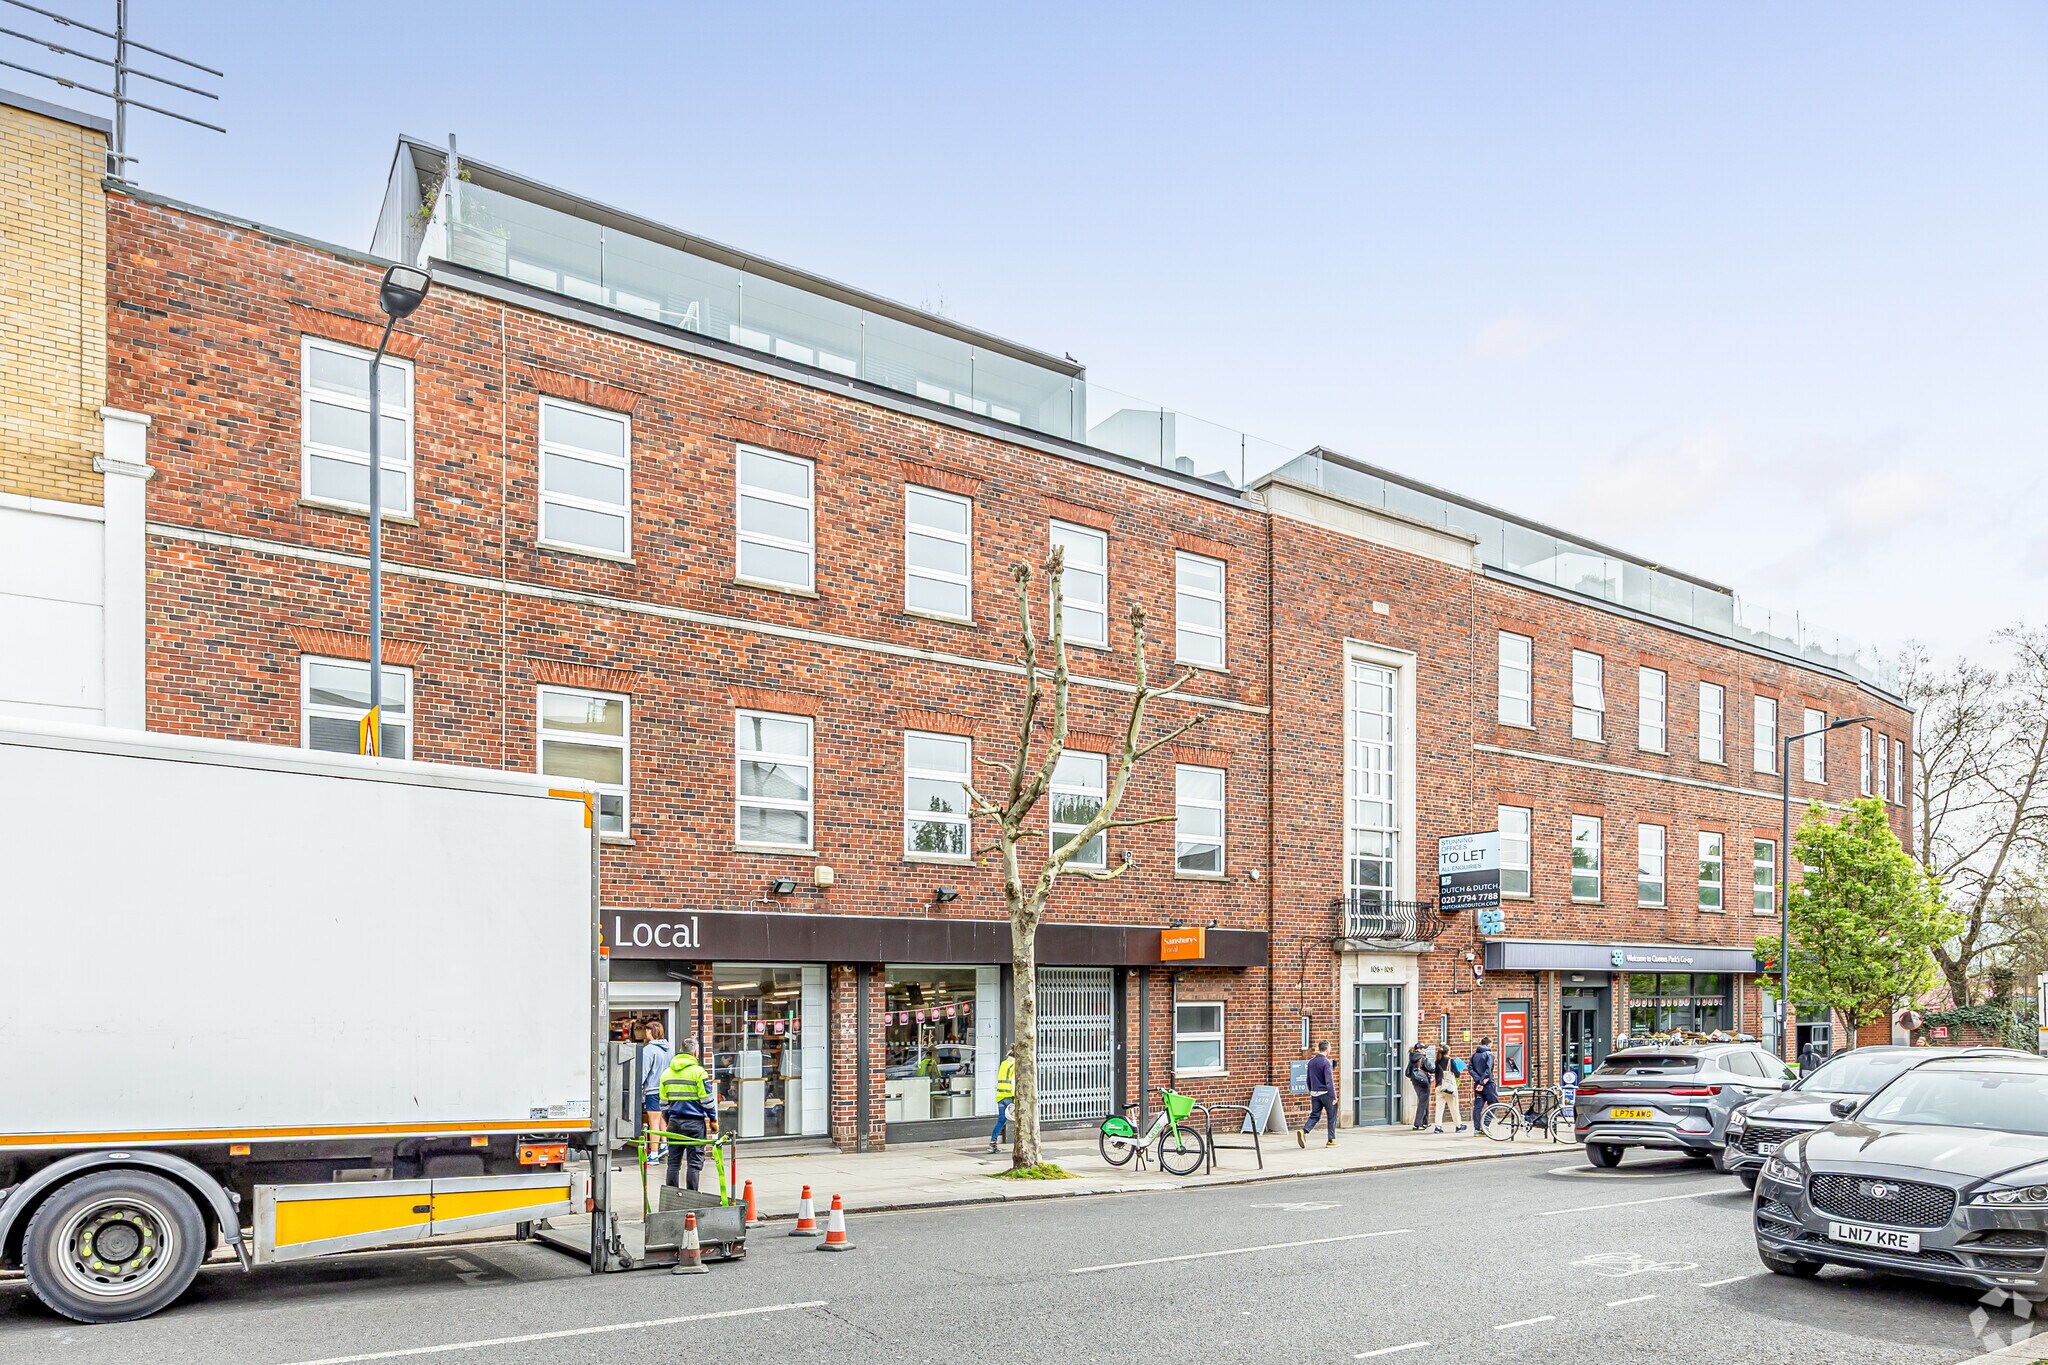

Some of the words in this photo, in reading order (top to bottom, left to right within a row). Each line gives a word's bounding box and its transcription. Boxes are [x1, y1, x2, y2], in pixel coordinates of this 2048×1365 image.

[1441, 837, 1473, 846] STUNNING
[1441, 844, 1467, 852] OFFICES
[1441, 852, 1459, 863] TO
[1463, 849, 1486, 861] LET
[1452, 863, 1482, 871] ENQUIRIES
[1441, 886, 1465, 894] DUTCH
[1473, 883, 1498, 891] DUTCH
[1441, 896, 1456, 904] 020
[1457, 894, 1477, 902] 7794
[1478, 892, 1498, 901] 7788
[1441, 901, 1498, 910] DUTCHANDDUTCH.COM
[615, 916, 700, 948] Local
[1163, 936, 1198, 945] Sainsbury's
[1163, 945, 1179, 953] Local
[1626, 954, 1646, 963] Welcome
[1646, 955, 1651, 963] to
[1652, 954, 1668, 963] Queens
[1680, 956, 1694, 965] Co-op
[1614, 1109, 1634, 1118] LP75
[1838, 1225, 1872, 1242] LN17
[1877, 1232, 1909, 1248] KRE
